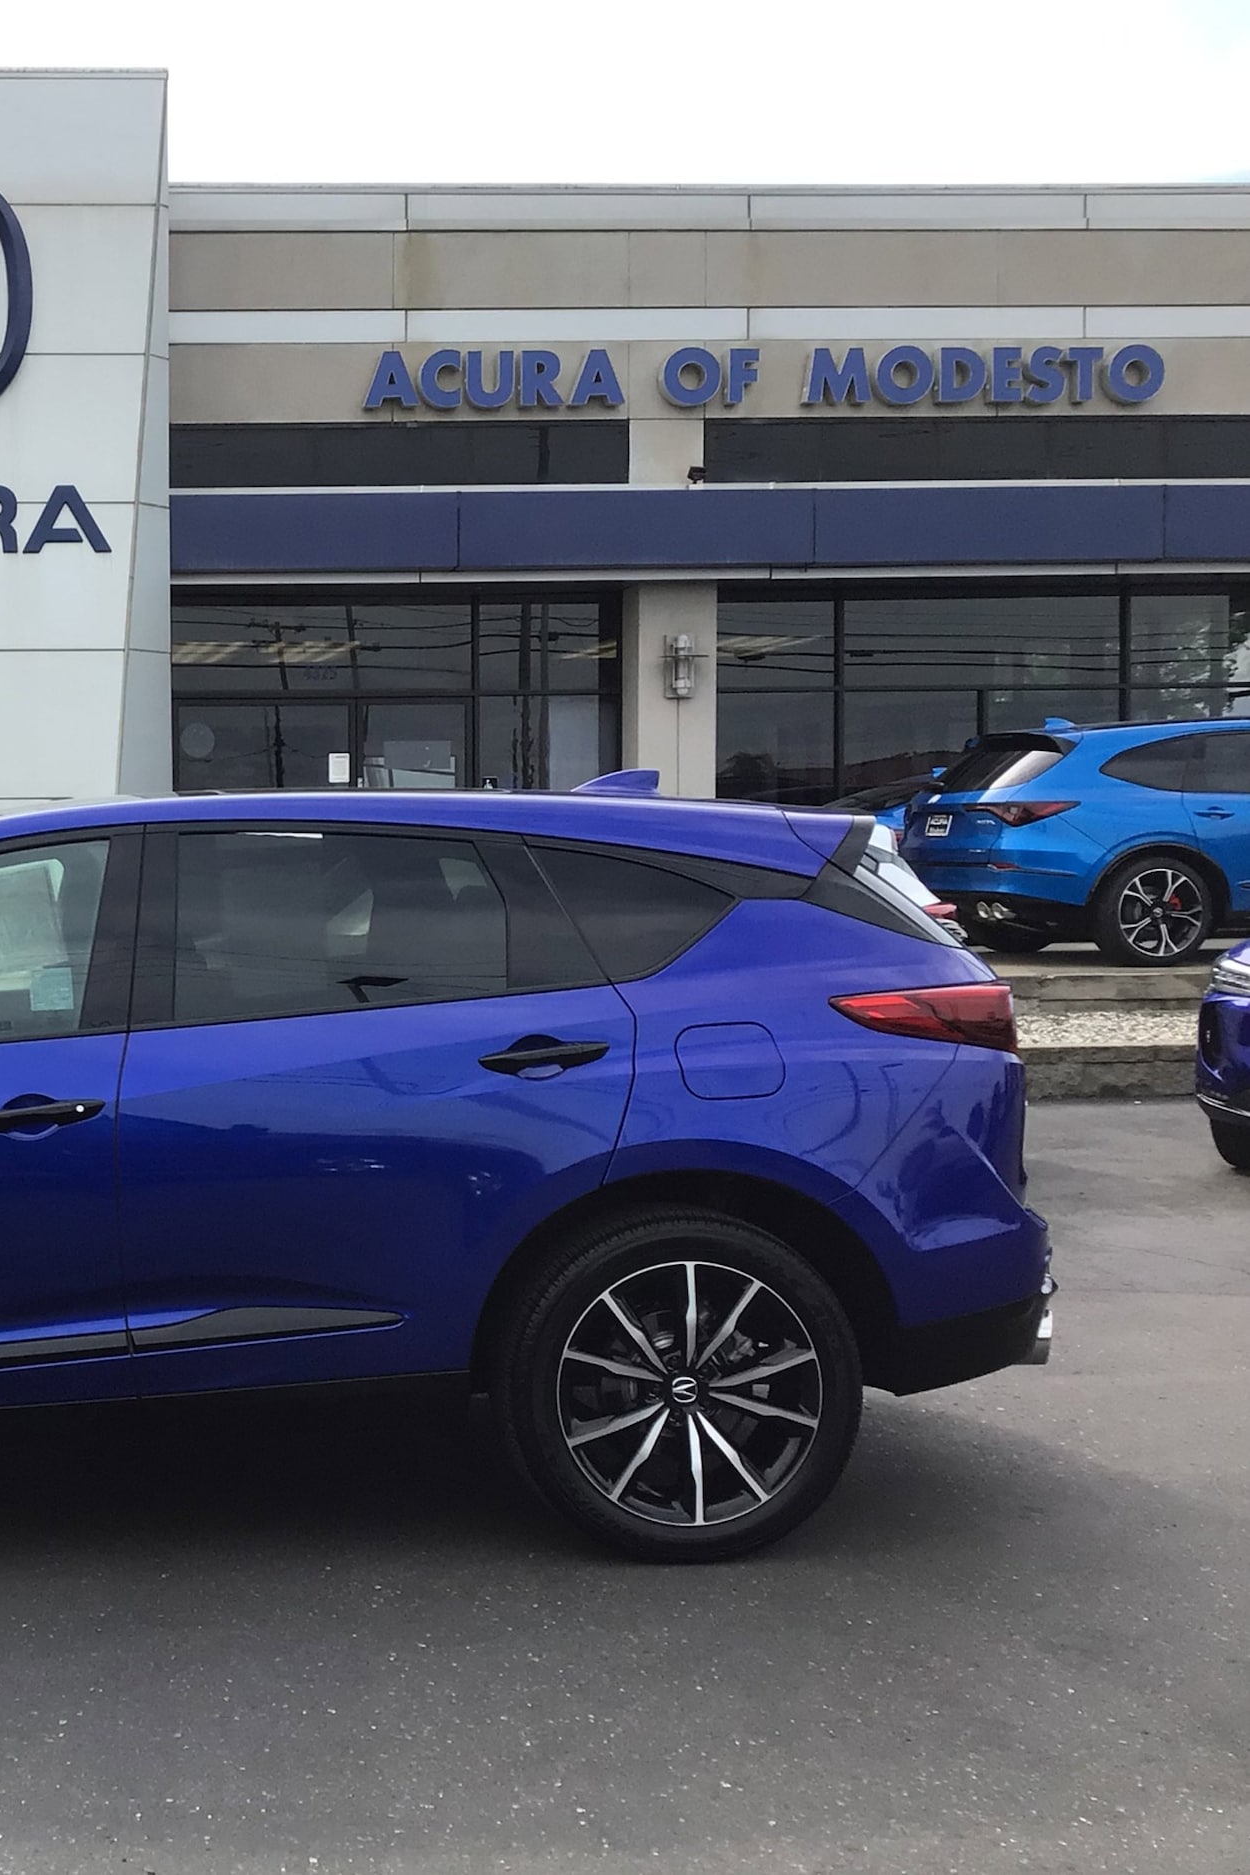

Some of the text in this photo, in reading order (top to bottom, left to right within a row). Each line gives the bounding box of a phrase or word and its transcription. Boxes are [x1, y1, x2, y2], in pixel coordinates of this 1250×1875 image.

[364, 343, 1166, 409] ACURA OF MODESTO
